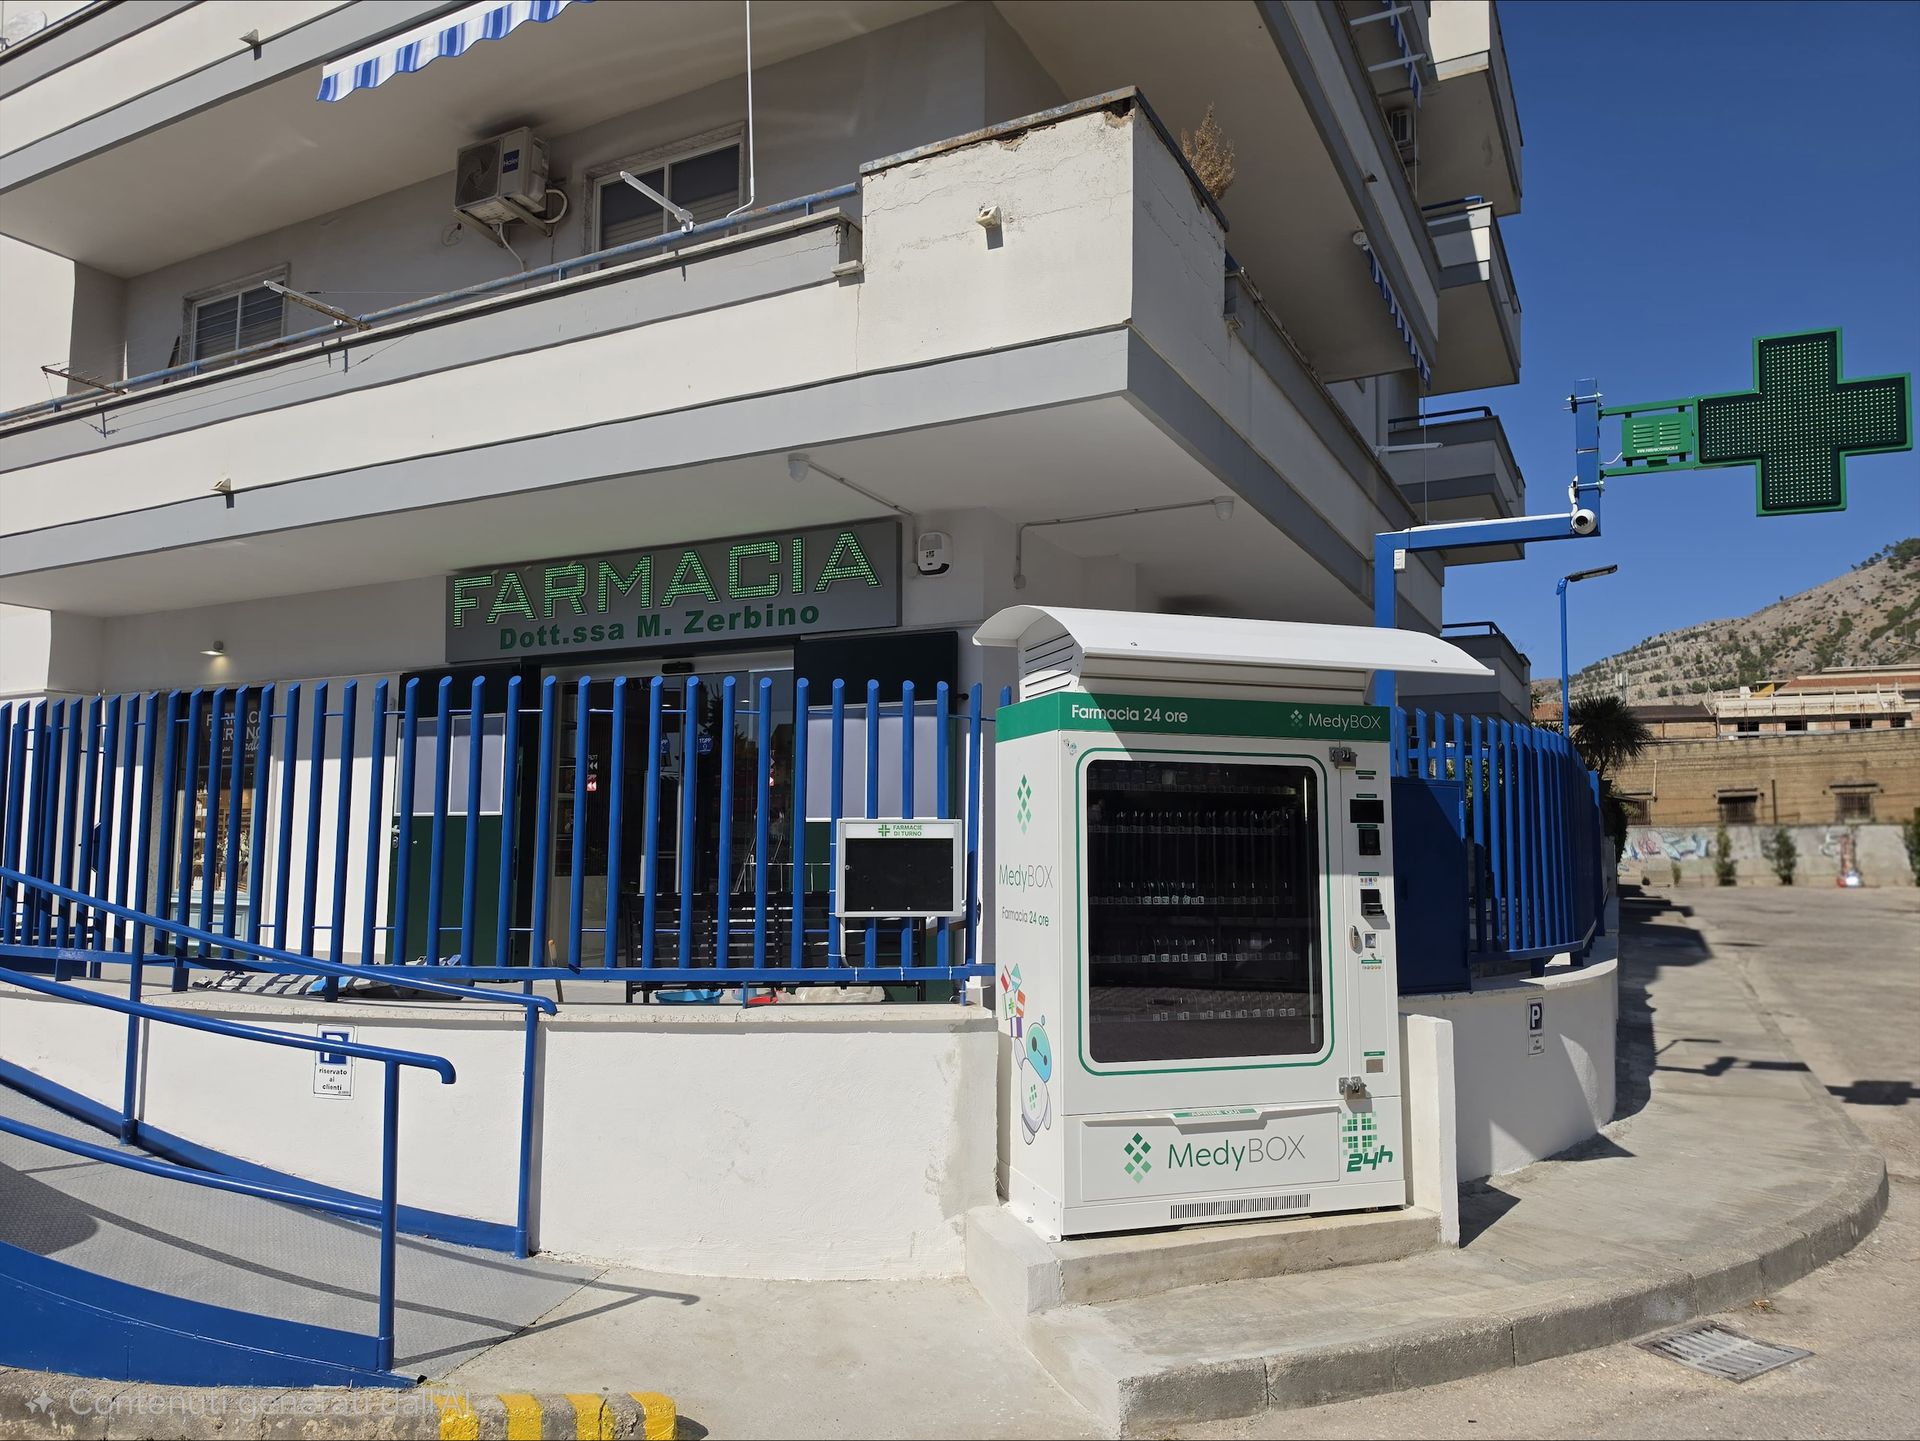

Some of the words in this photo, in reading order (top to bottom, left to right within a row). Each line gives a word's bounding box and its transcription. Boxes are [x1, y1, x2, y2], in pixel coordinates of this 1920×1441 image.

[453, 531, 883, 629] FARMACIA
[500, 621, 625, 650] Dott.ssa
[636, 614, 672, 638] M.
[683, 603, 820, 634] Zerbino
[1071, 704, 1139, 721] Farmacia
[1143, 707, 1161, 722] 24
[1165, 711, 1188, 723] ore
[1308, 712, 1381, 732] MedyBOX
[999, 864, 1054, 893] MedyBOX
[1001, 905, 1028, 923] Farmacia
[1029, 910, 1037, 925] 24
[1038, 914, 1049, 927] ore
[1531, 1005, 1541, 1028] P
[319, 1068, 348, 1076] riservato
[322, 1083, 342, 1091] clienti
[1167, 1134, 1306, 1172] MedyBOX
[1346, 1145, 1393, 1172] 24h
